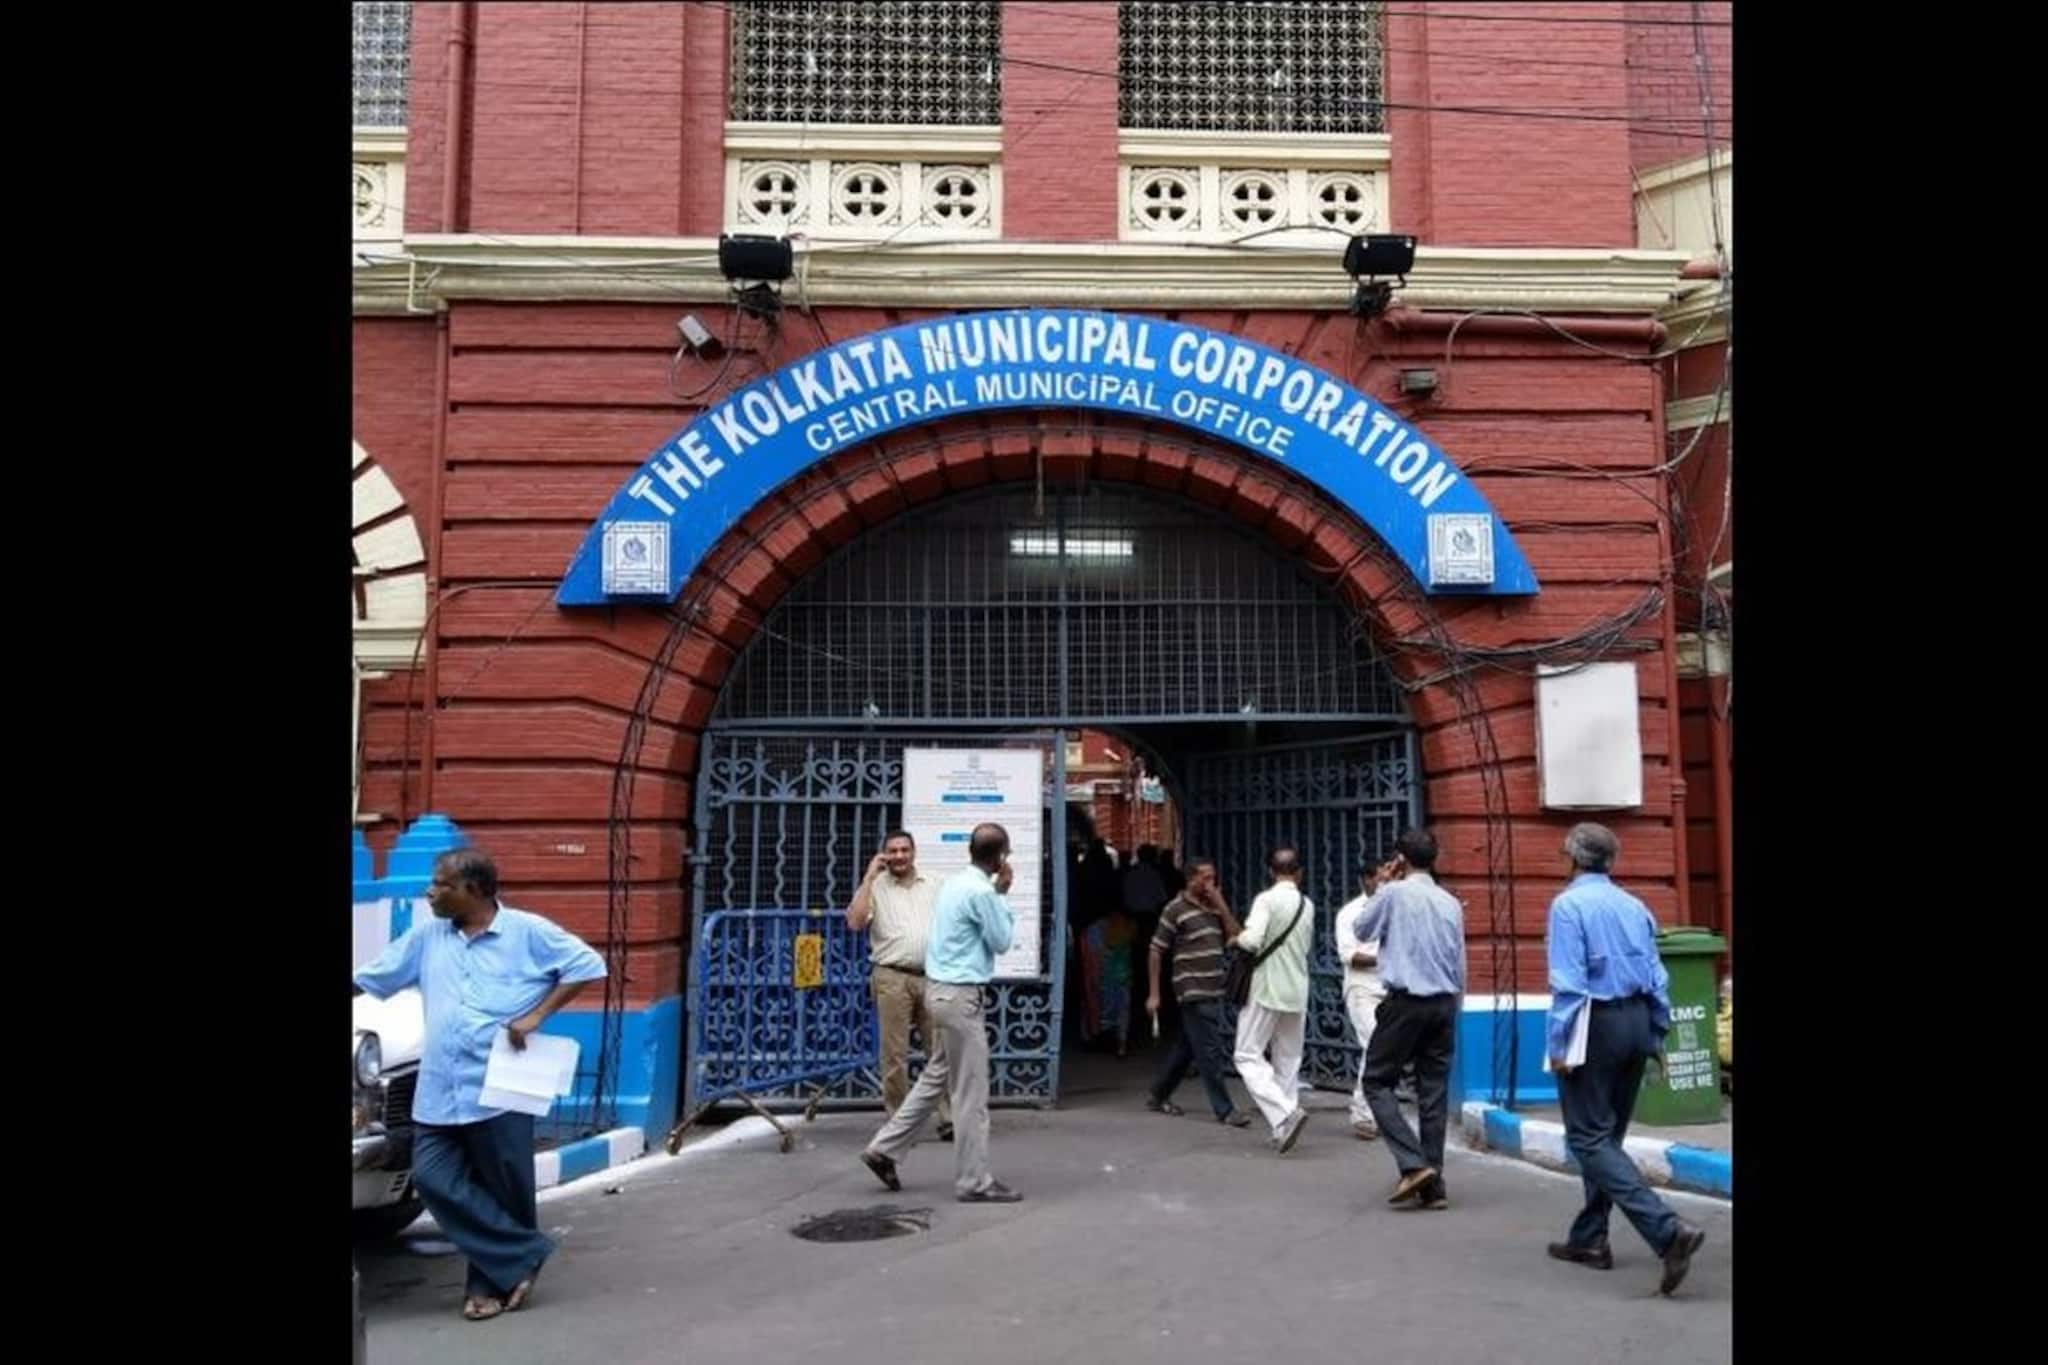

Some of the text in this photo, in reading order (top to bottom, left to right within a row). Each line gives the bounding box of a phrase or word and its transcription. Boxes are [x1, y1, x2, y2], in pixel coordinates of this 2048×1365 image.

[627, 315, 1458, 516] THE KOLKATA MUNICIPAL CORPORATION
[804, 371, 1295, 457] CENTRAL MUNICIPAL OFFICE
[1669, 1073, 1714, 1091] USE ME
